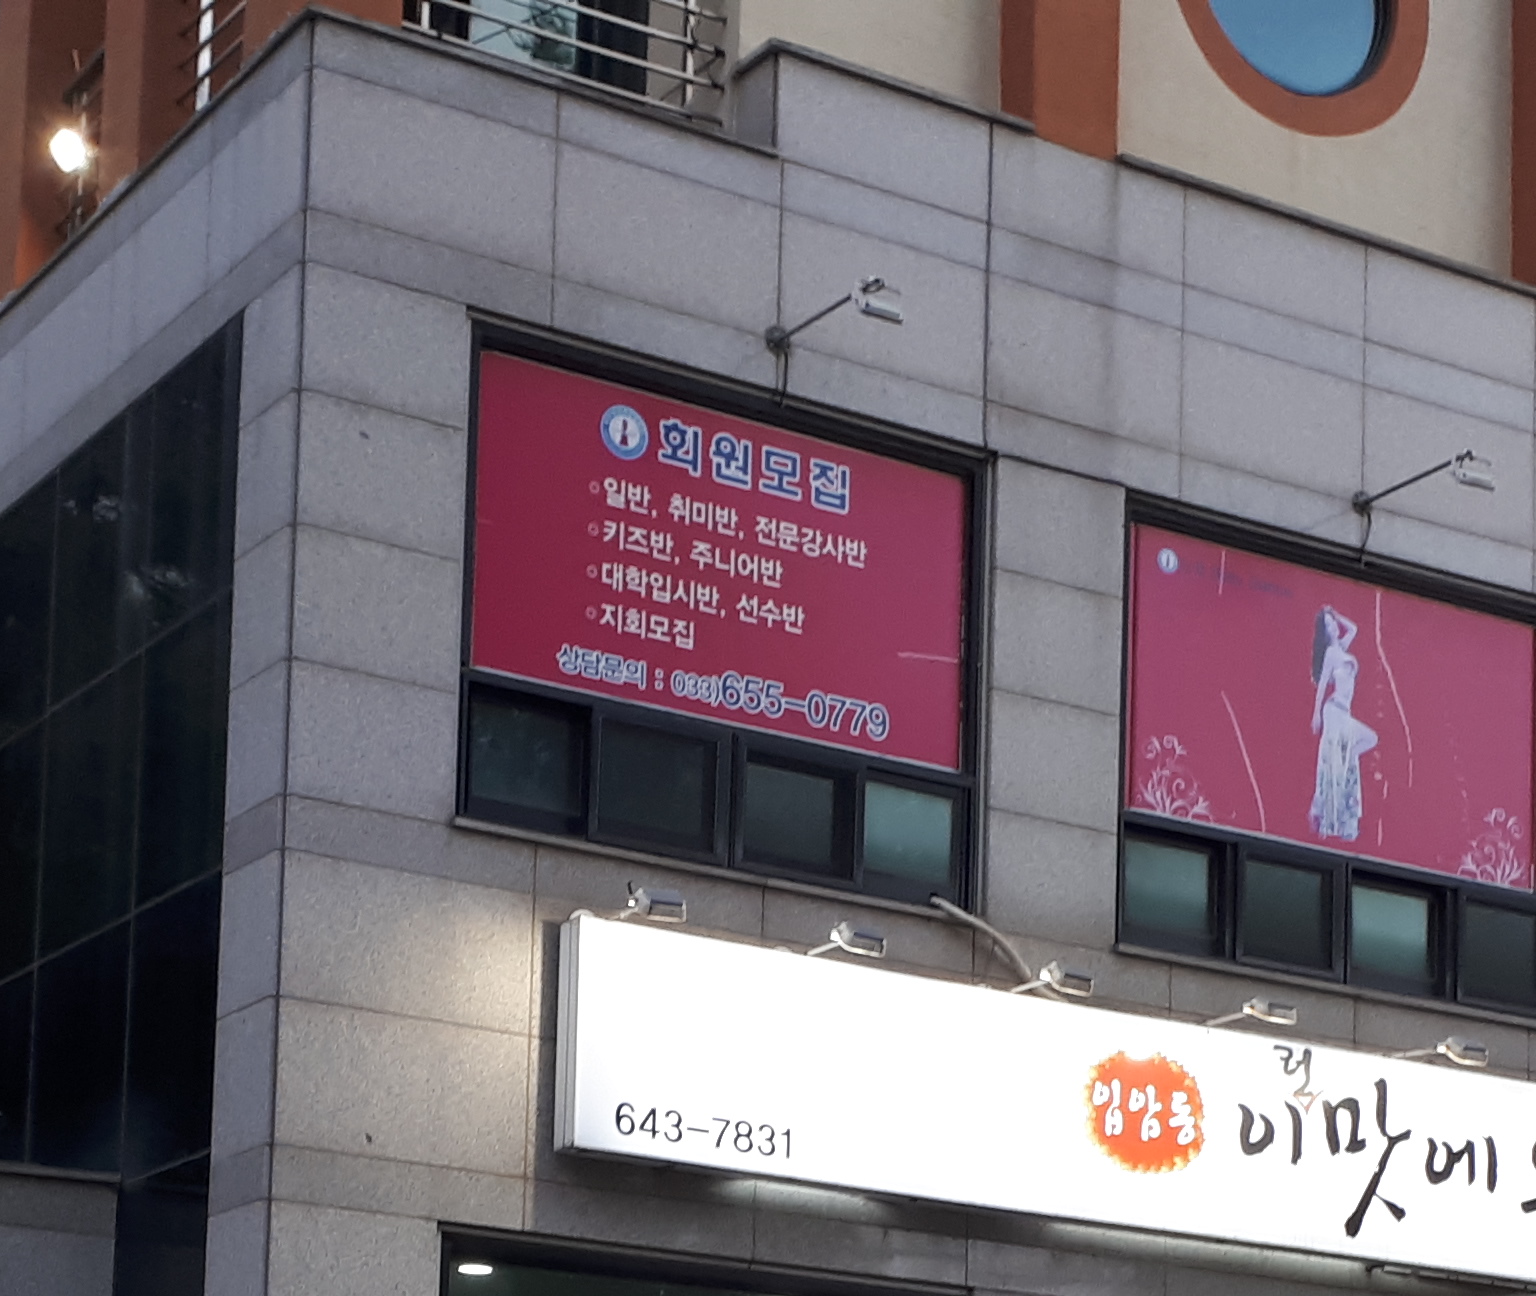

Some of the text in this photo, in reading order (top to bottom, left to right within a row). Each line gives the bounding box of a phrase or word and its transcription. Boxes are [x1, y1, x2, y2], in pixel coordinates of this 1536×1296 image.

[658, 418, 851, 515] 회원모집
[602, 520, 784, 589] 키즈반, 주니어반
[603, 477, 867, 570] 일반, 취미반, 전문강사반
[598, 603, 696, 651] 지회모집
[600, 561, 805, 635] 대학입시반, 선수반
[556, 643, 647, 690] 상담문의
[670, 669, 890, 741] 033)655-0779
[614, 1102, 793, 1160] 643-7831
